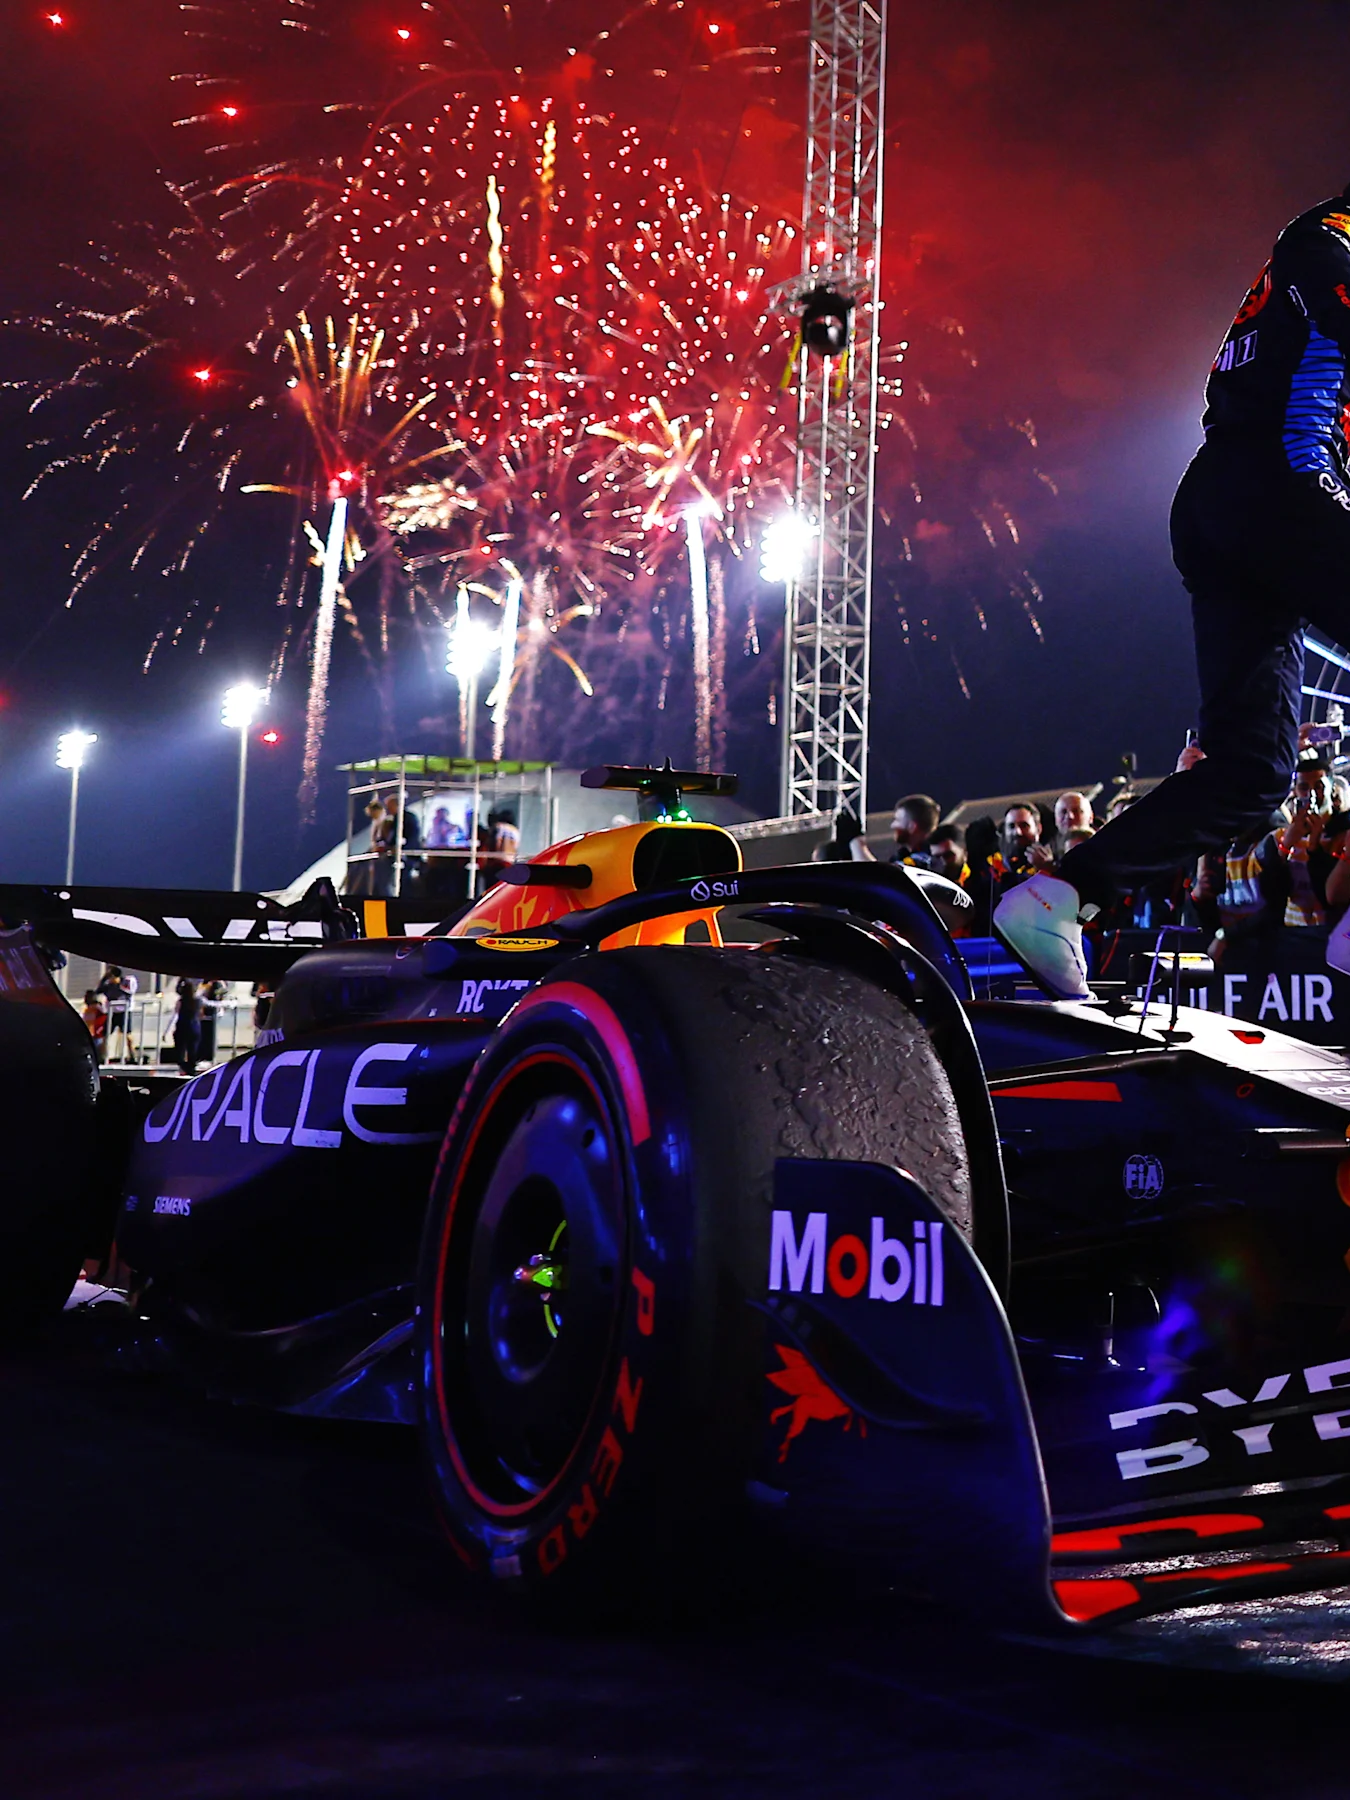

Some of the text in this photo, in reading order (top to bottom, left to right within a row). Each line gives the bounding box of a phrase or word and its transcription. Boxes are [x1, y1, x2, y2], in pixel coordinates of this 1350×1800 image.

[712, 880, 739, 899] Sui
[1257, 973, 1334, 1023] AIR
[143, 1042, 447, 1149] ORACLE
[768, 1209, 944, 1307] Mobil
